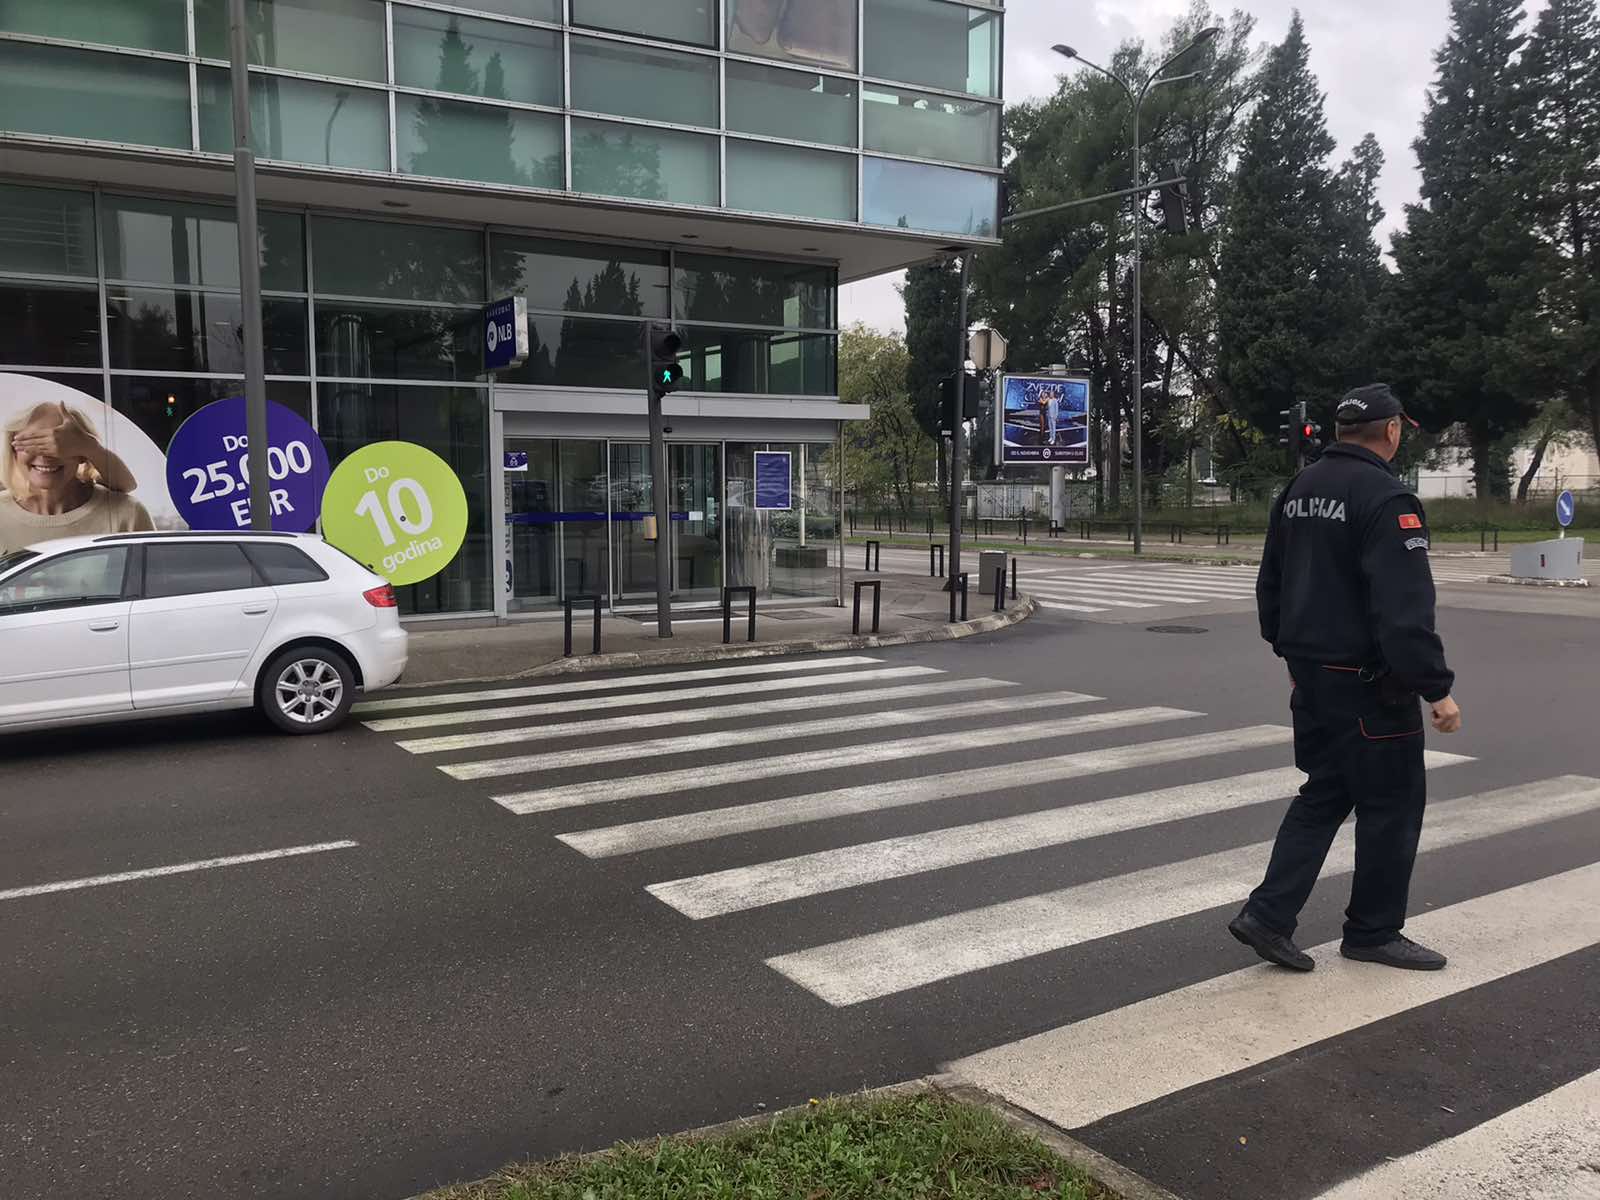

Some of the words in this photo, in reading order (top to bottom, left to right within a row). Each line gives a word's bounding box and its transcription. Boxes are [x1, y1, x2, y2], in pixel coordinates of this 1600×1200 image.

[498, 323, 512, 342] NLB
[222, 435, 248, 452] Do
[363, 466, 390, 484] Do
[230, 488, 295, 527] ER
[354, 477, 433, 547] 10
[1283, 497, 1346, 522] OLIIJA
[382, 536, 443, 573] godina
